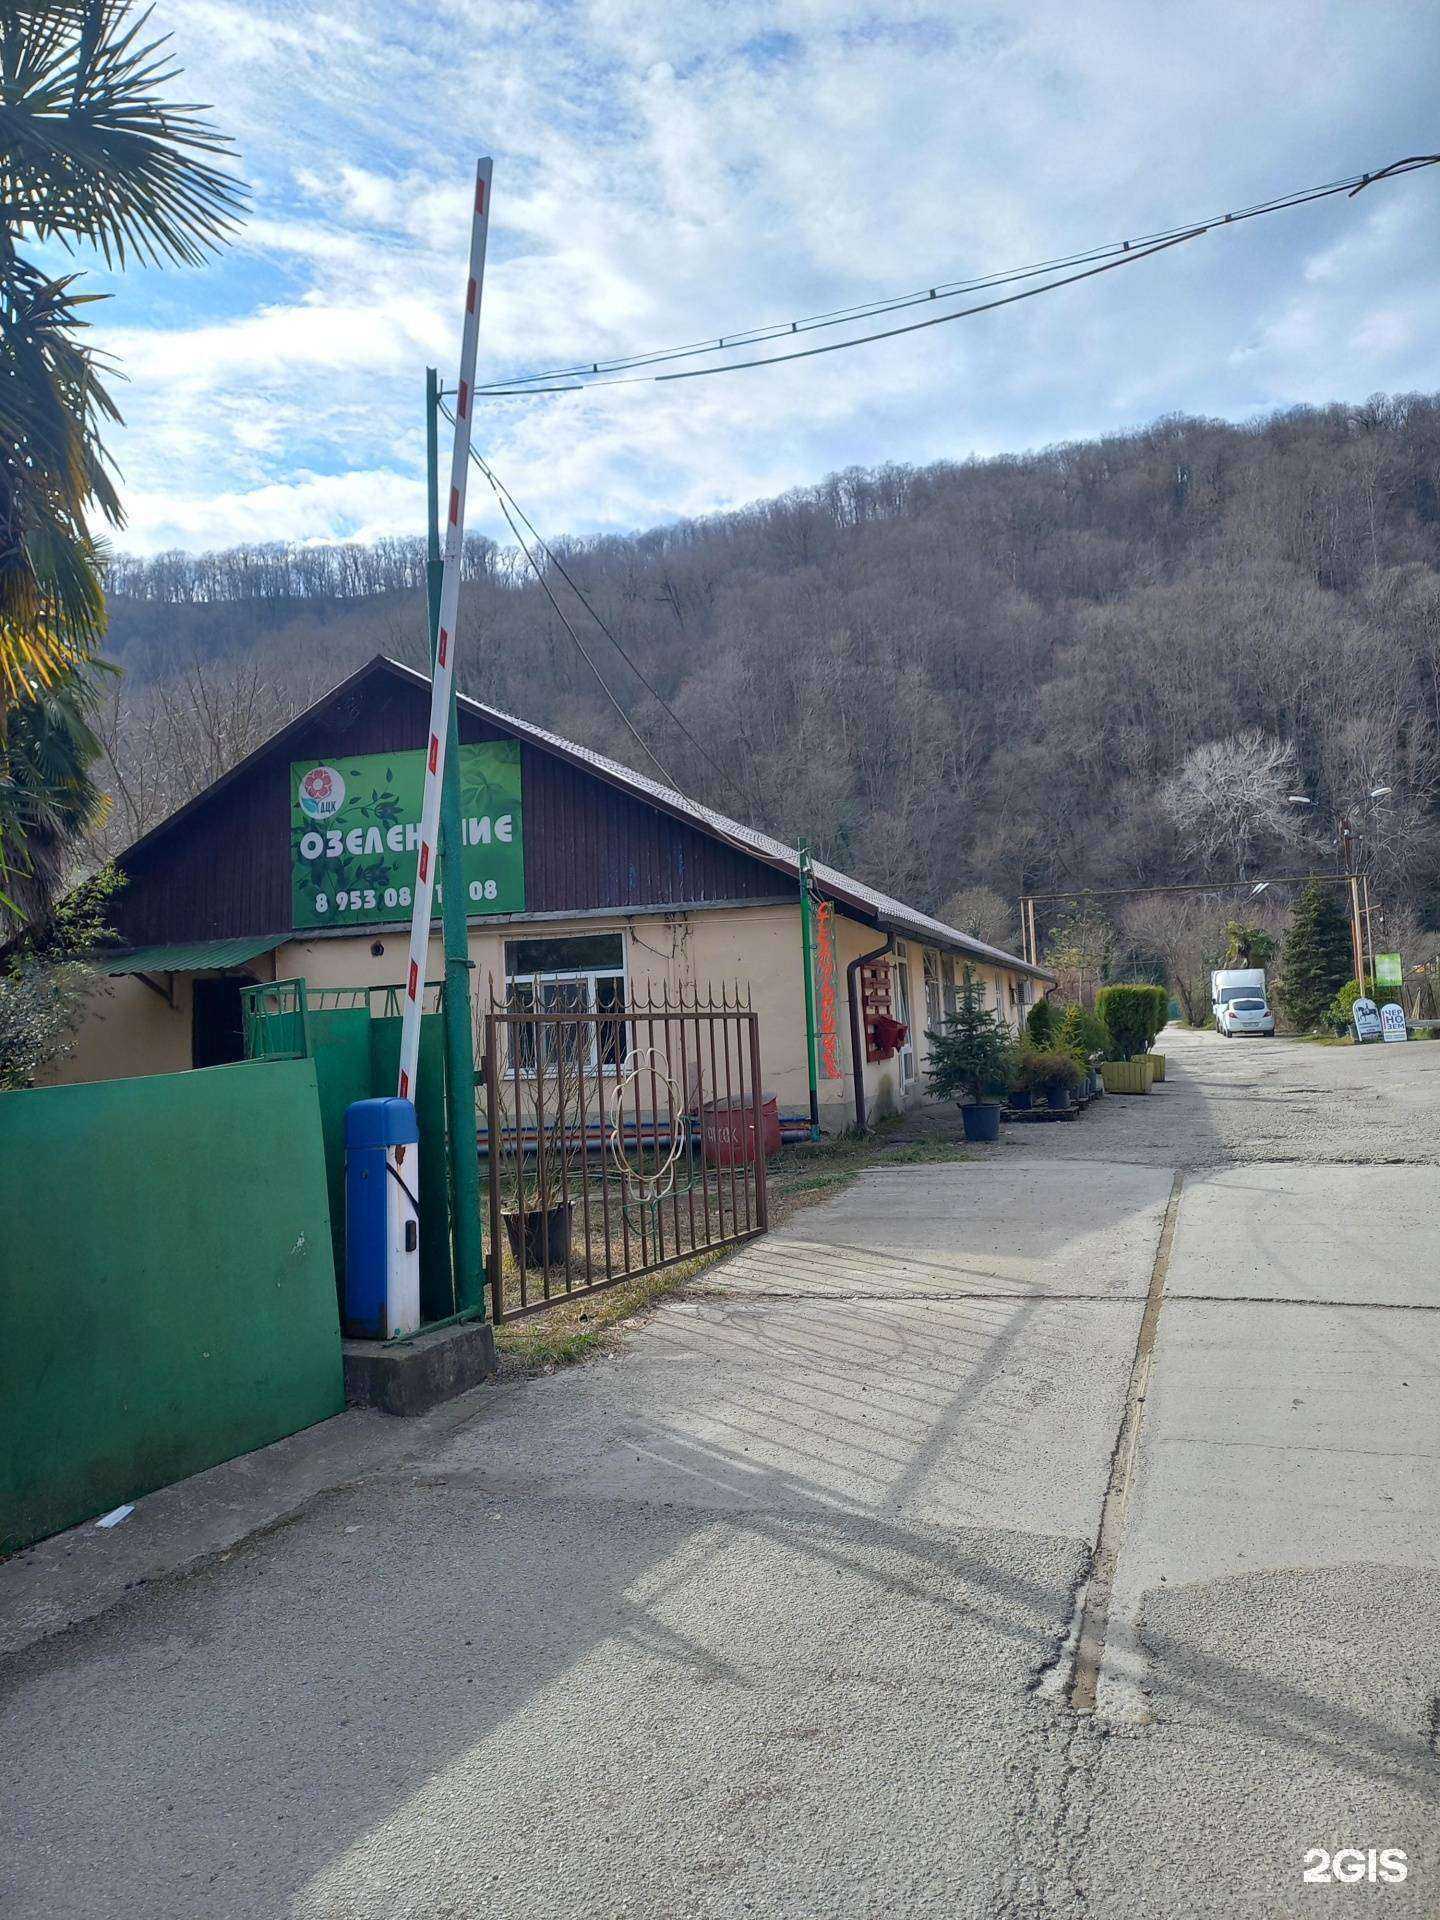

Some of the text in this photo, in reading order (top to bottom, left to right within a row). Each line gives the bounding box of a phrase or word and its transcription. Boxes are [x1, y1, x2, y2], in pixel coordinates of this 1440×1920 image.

[320, 801, 336, 813] ДЦК
[300, 815, 513, 857] ОЗЕЛЕНИЕ
[316, 893, 328, 912] 8
[336, 890, 376, 910] 953
[384, 887, 412, 907] 08
[469, 880, 497, 900] 08
